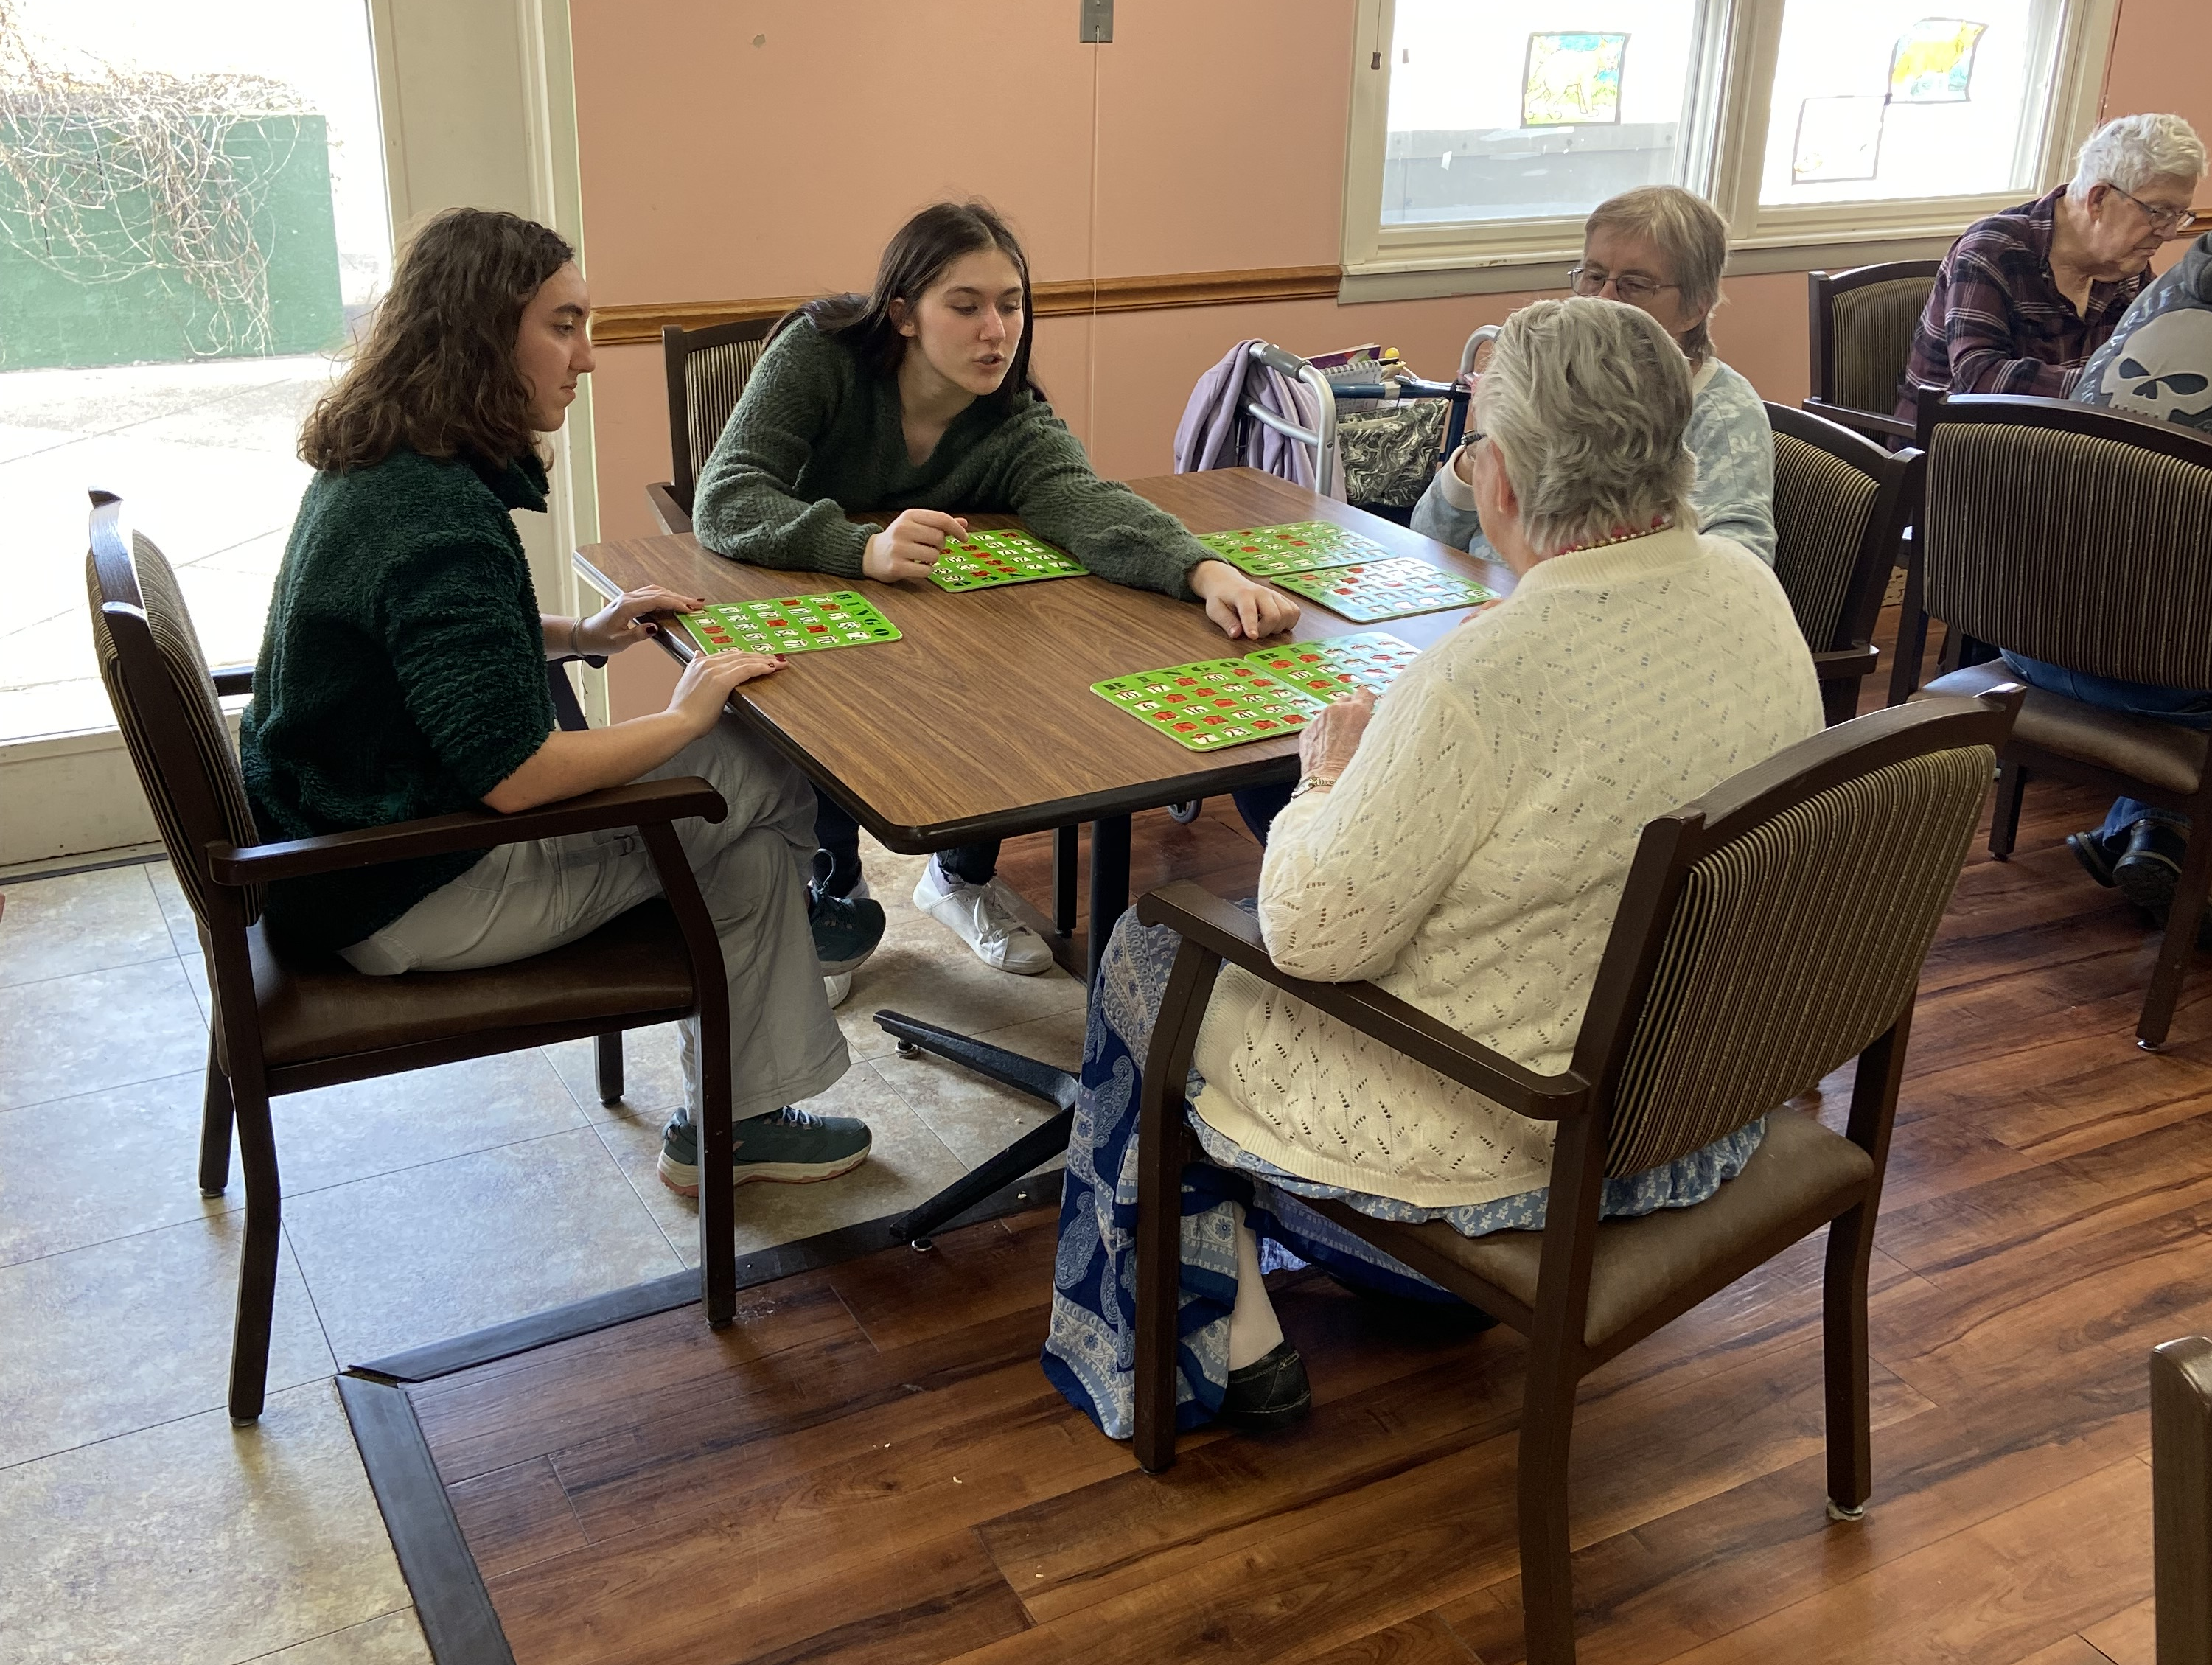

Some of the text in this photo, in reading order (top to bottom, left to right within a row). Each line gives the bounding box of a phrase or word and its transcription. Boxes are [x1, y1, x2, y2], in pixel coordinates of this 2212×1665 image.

[1207, 672, 1227, 682] 60
[1120, 691, 1140, 700] 10
[1246, 694, 1266, 703] 46
[1187, 706, 1207, 715] 16
